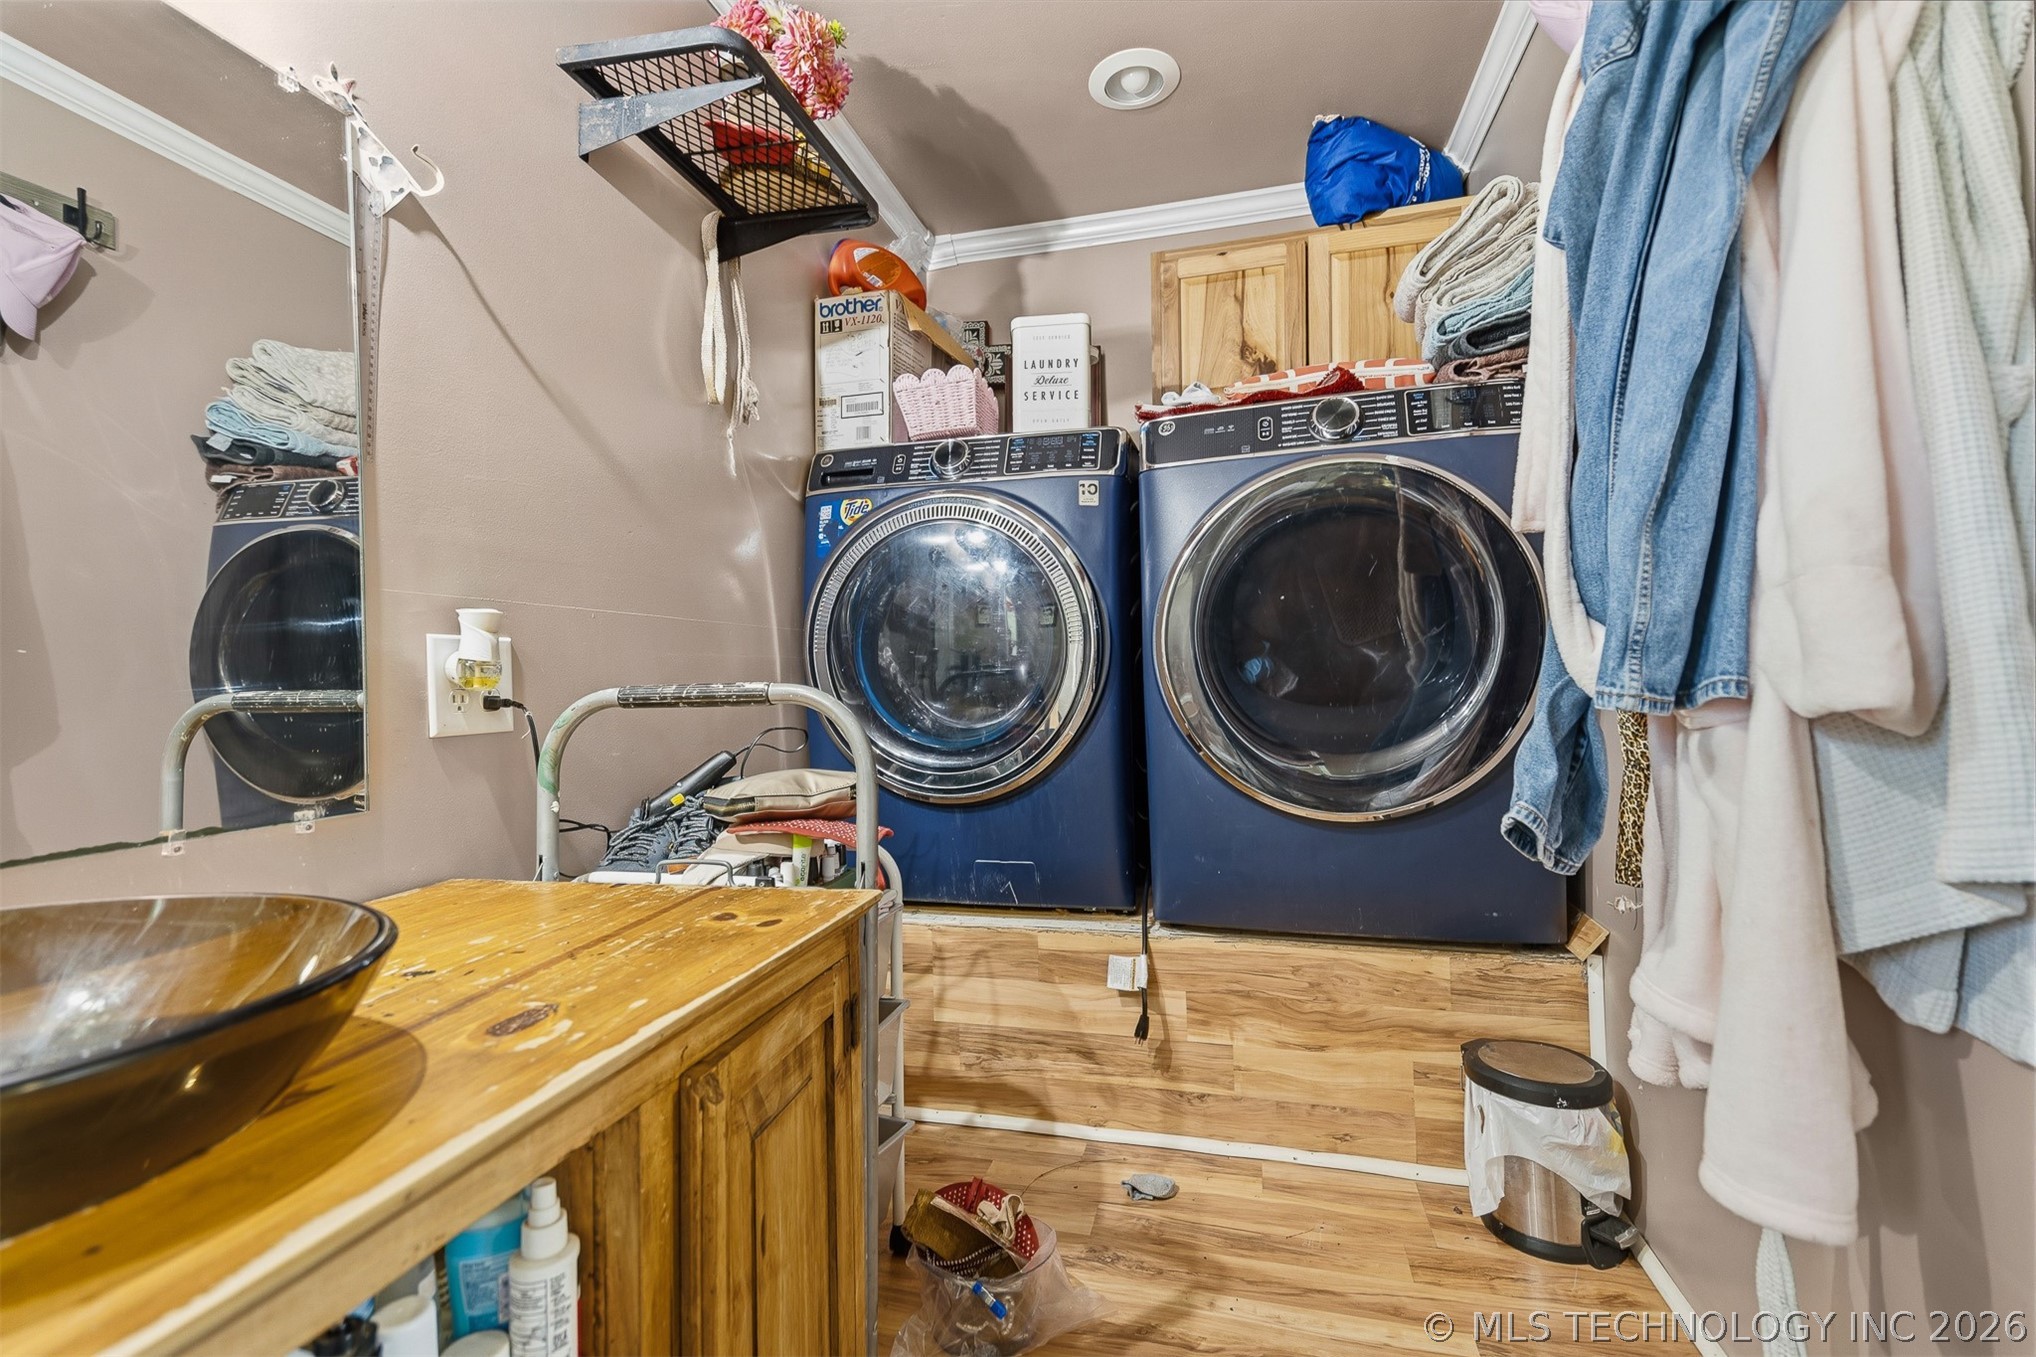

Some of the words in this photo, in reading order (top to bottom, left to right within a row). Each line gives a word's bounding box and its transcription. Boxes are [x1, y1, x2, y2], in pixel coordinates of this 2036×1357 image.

[820, 298, 881, 318] brother
[845, 314, 882, 327] VX-1120
[1024, 358, 1079, 370] LAUNDRY
[1034, 375, 1069, 385] Deluxe
[1024, 390, 1079, 401] SERVICE
[844, 501, 869, 520] Tide
